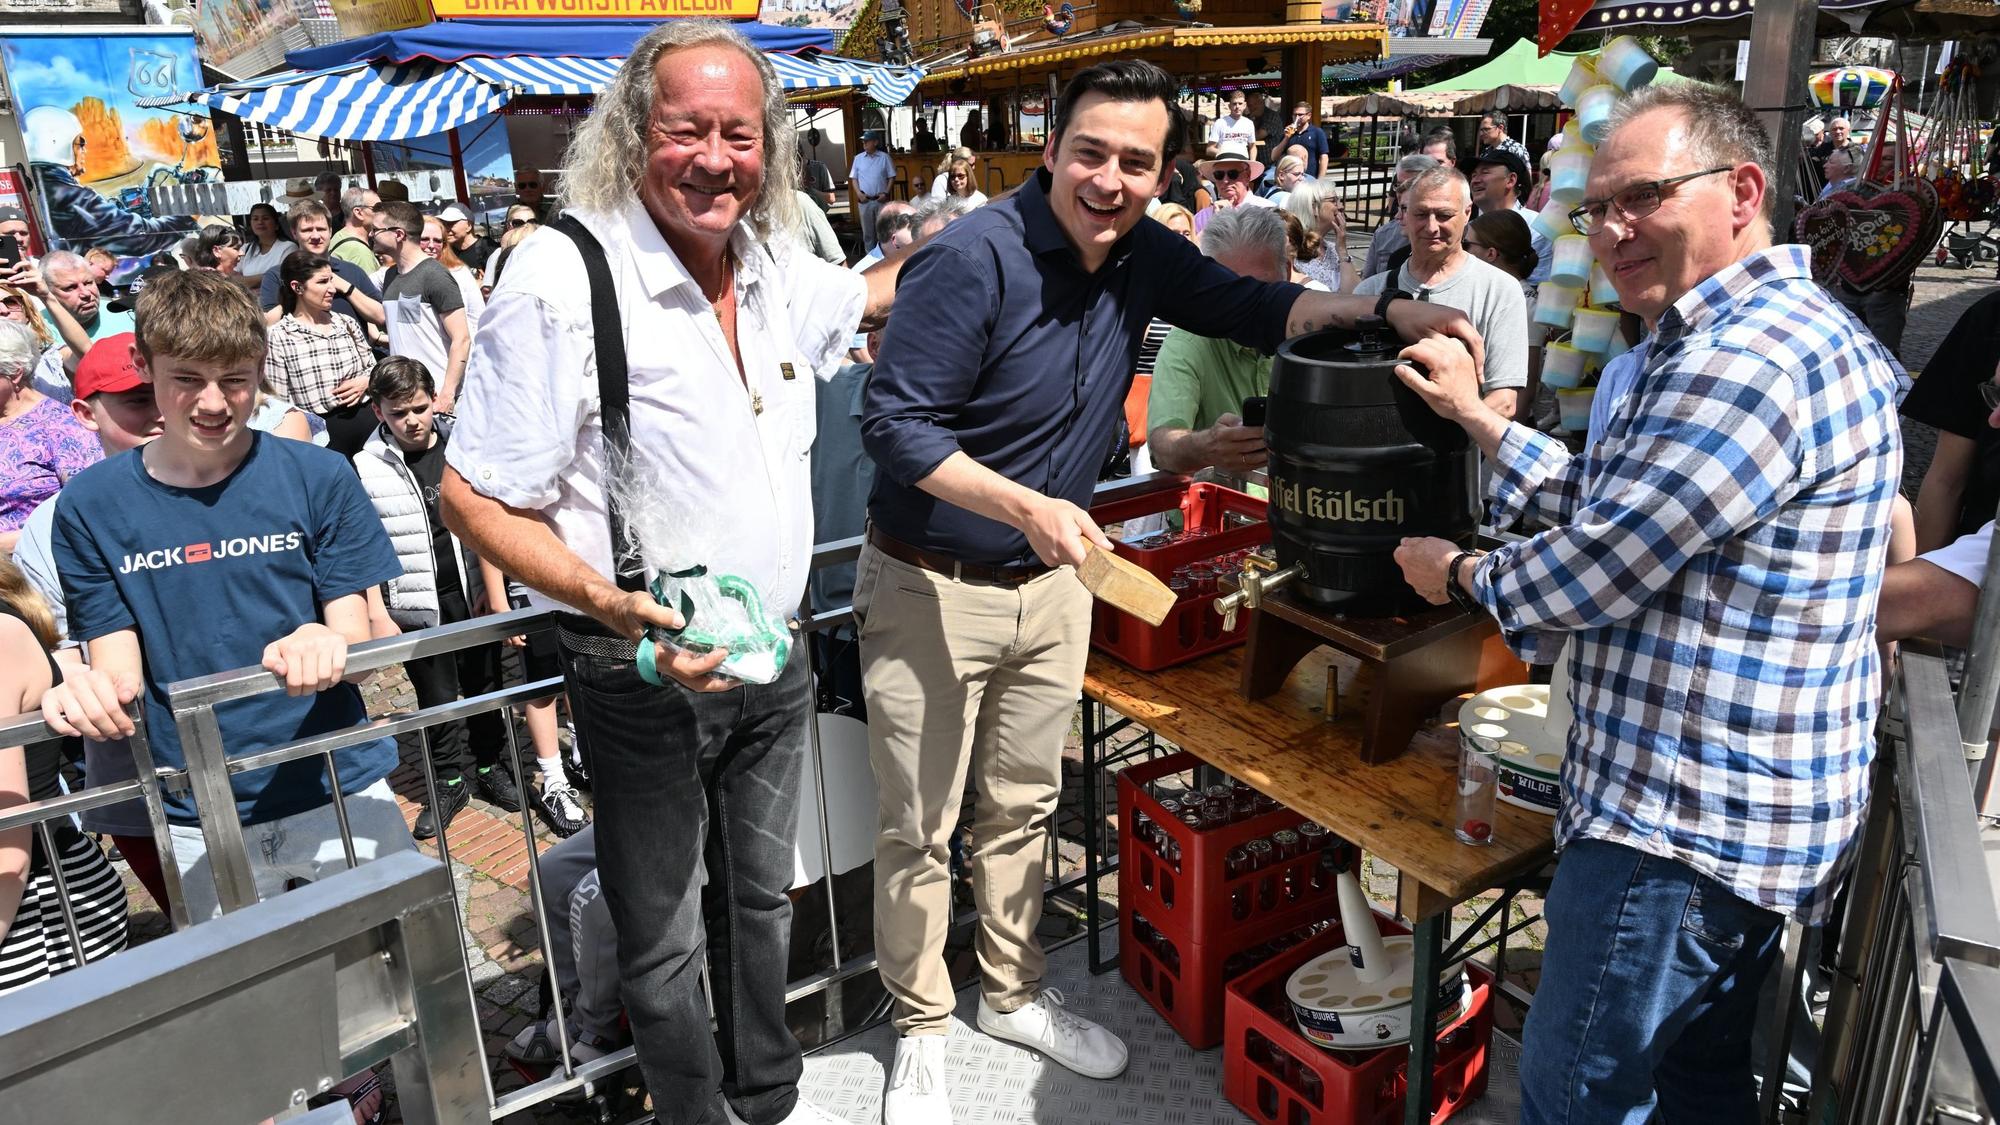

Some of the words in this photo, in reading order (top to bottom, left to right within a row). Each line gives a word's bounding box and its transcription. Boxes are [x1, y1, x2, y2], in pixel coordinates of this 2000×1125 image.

[137, 62, 169, 88] 66
[1306, 486, 1404, 525] Kölsch
[119, 547, 184, 574] JACK
[213, 531, 300, 559] JONES
[1519, 776, 1553, 794] WILDE
